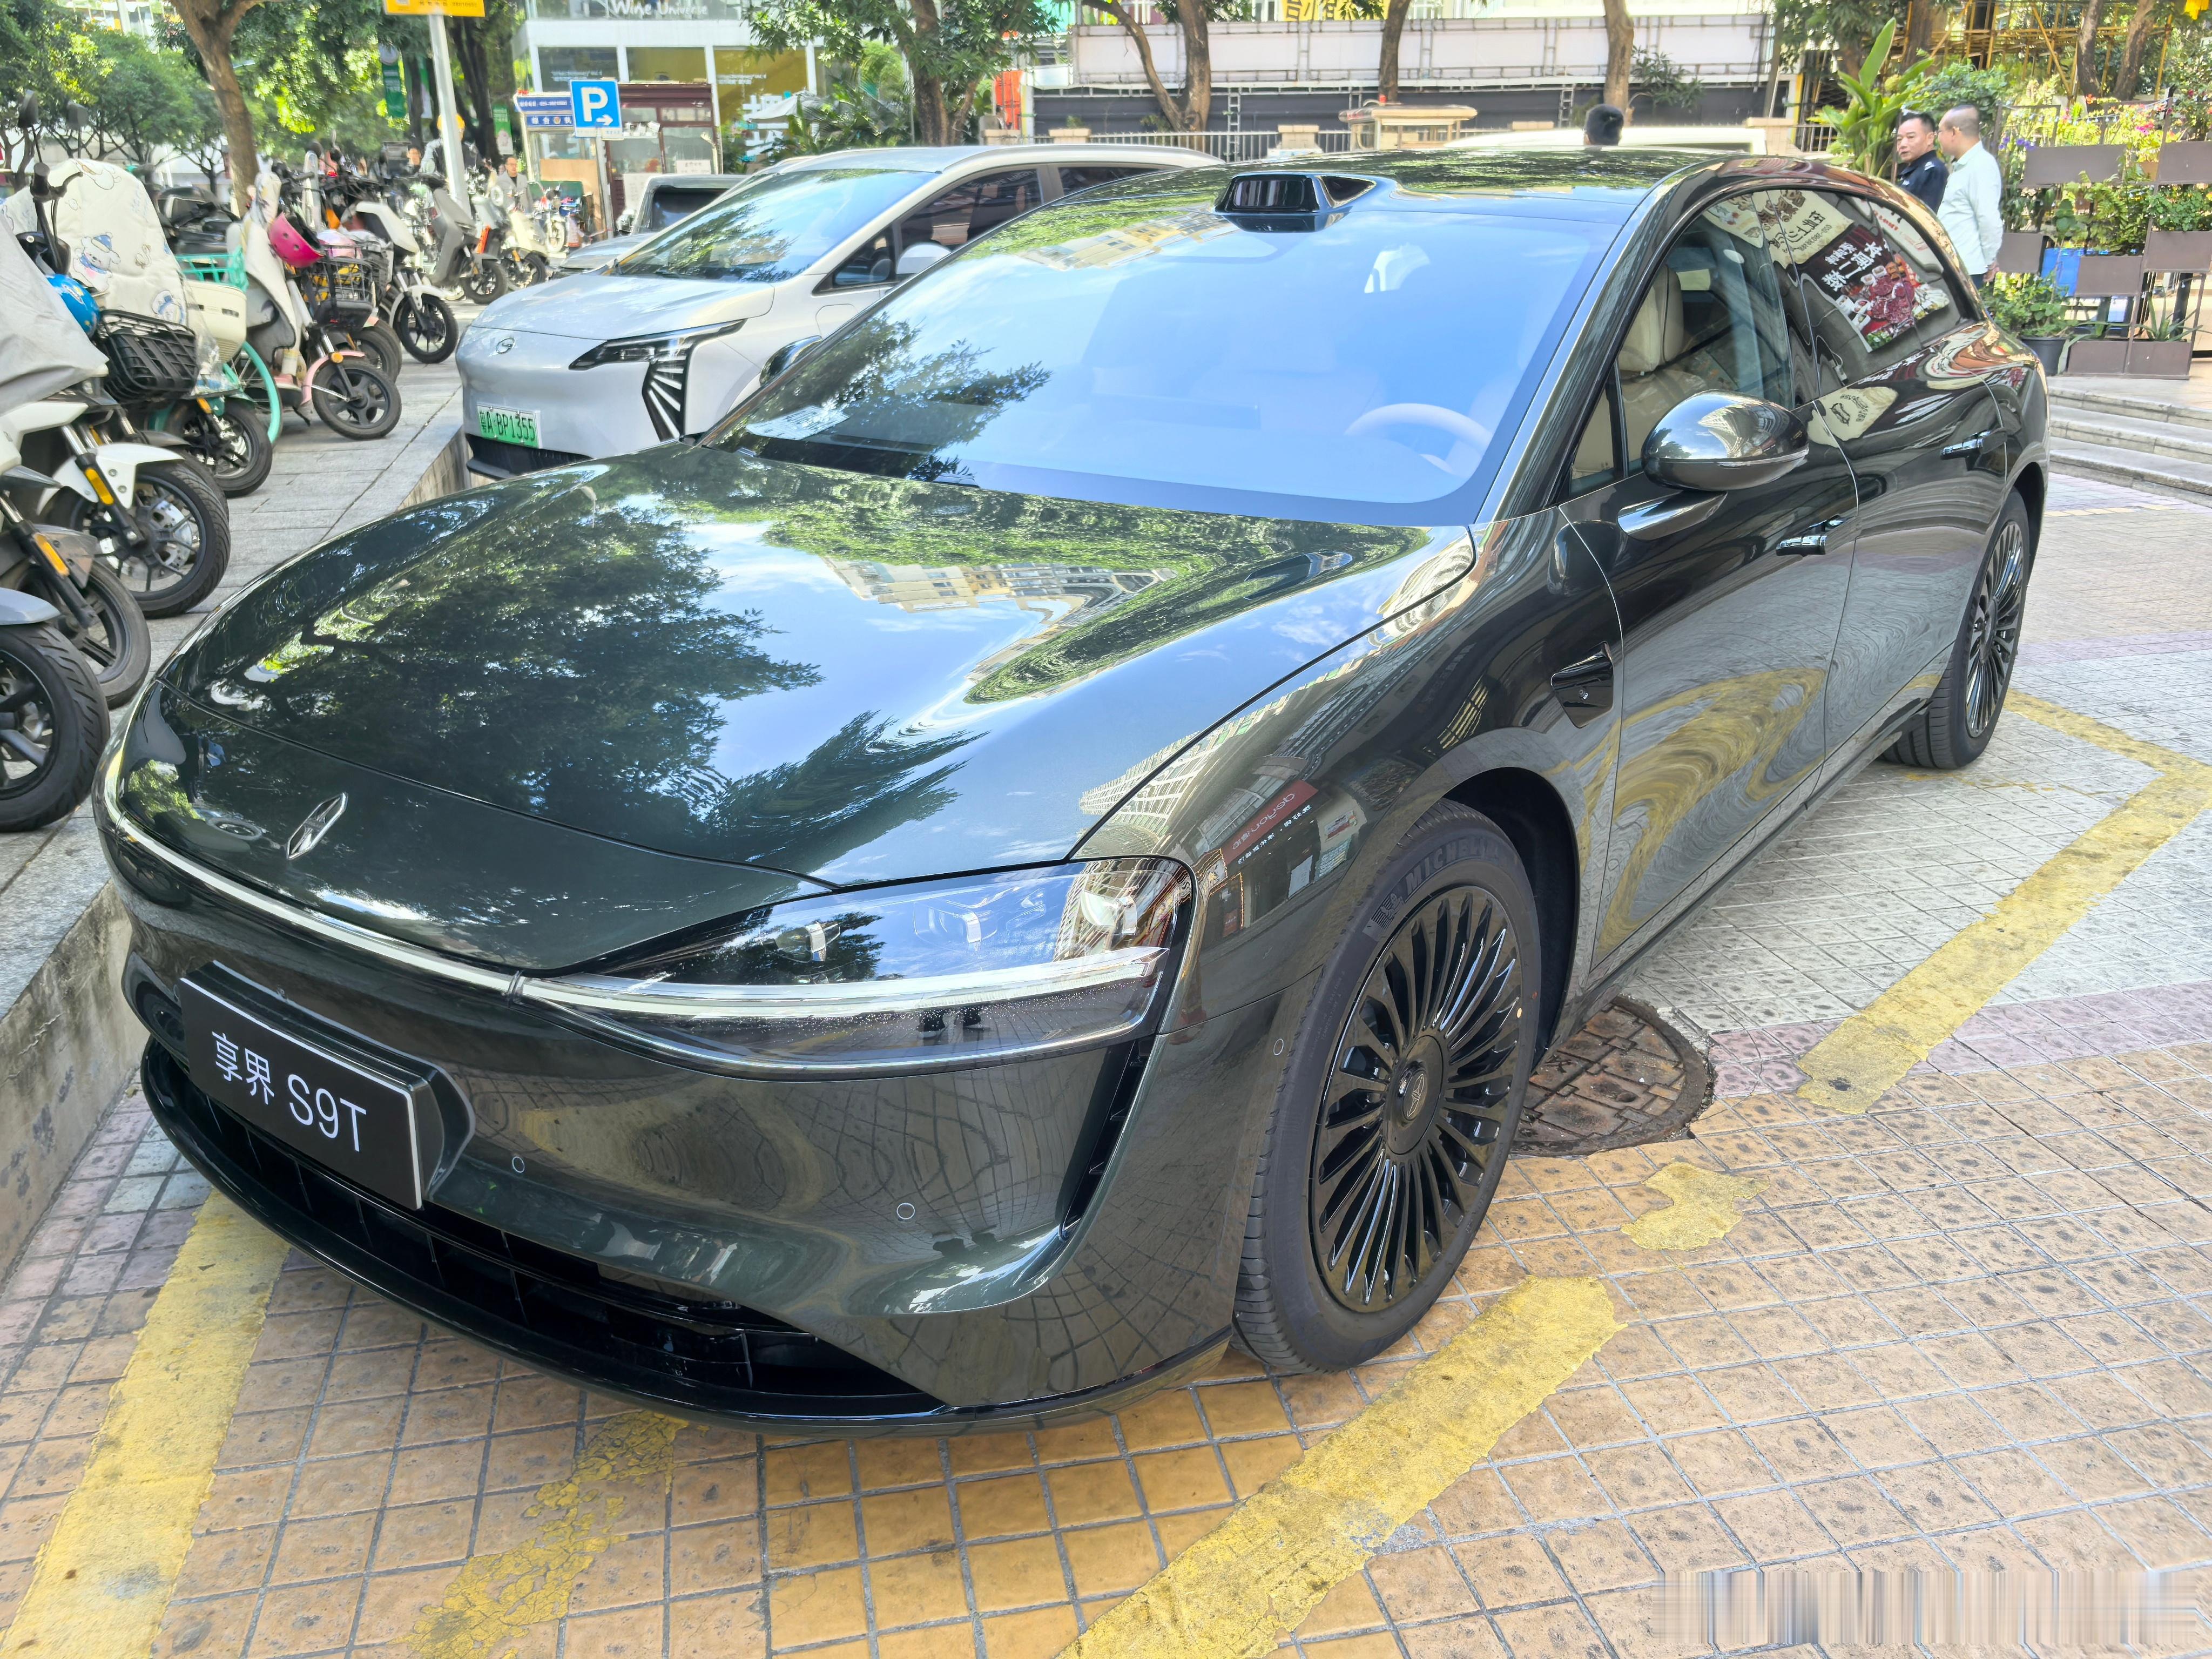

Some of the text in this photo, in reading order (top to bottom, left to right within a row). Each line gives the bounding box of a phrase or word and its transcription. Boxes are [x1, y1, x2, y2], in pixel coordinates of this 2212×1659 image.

[581, 86, 608, 122] P
[212, 1031, 367, 1152] 享界 S9T
